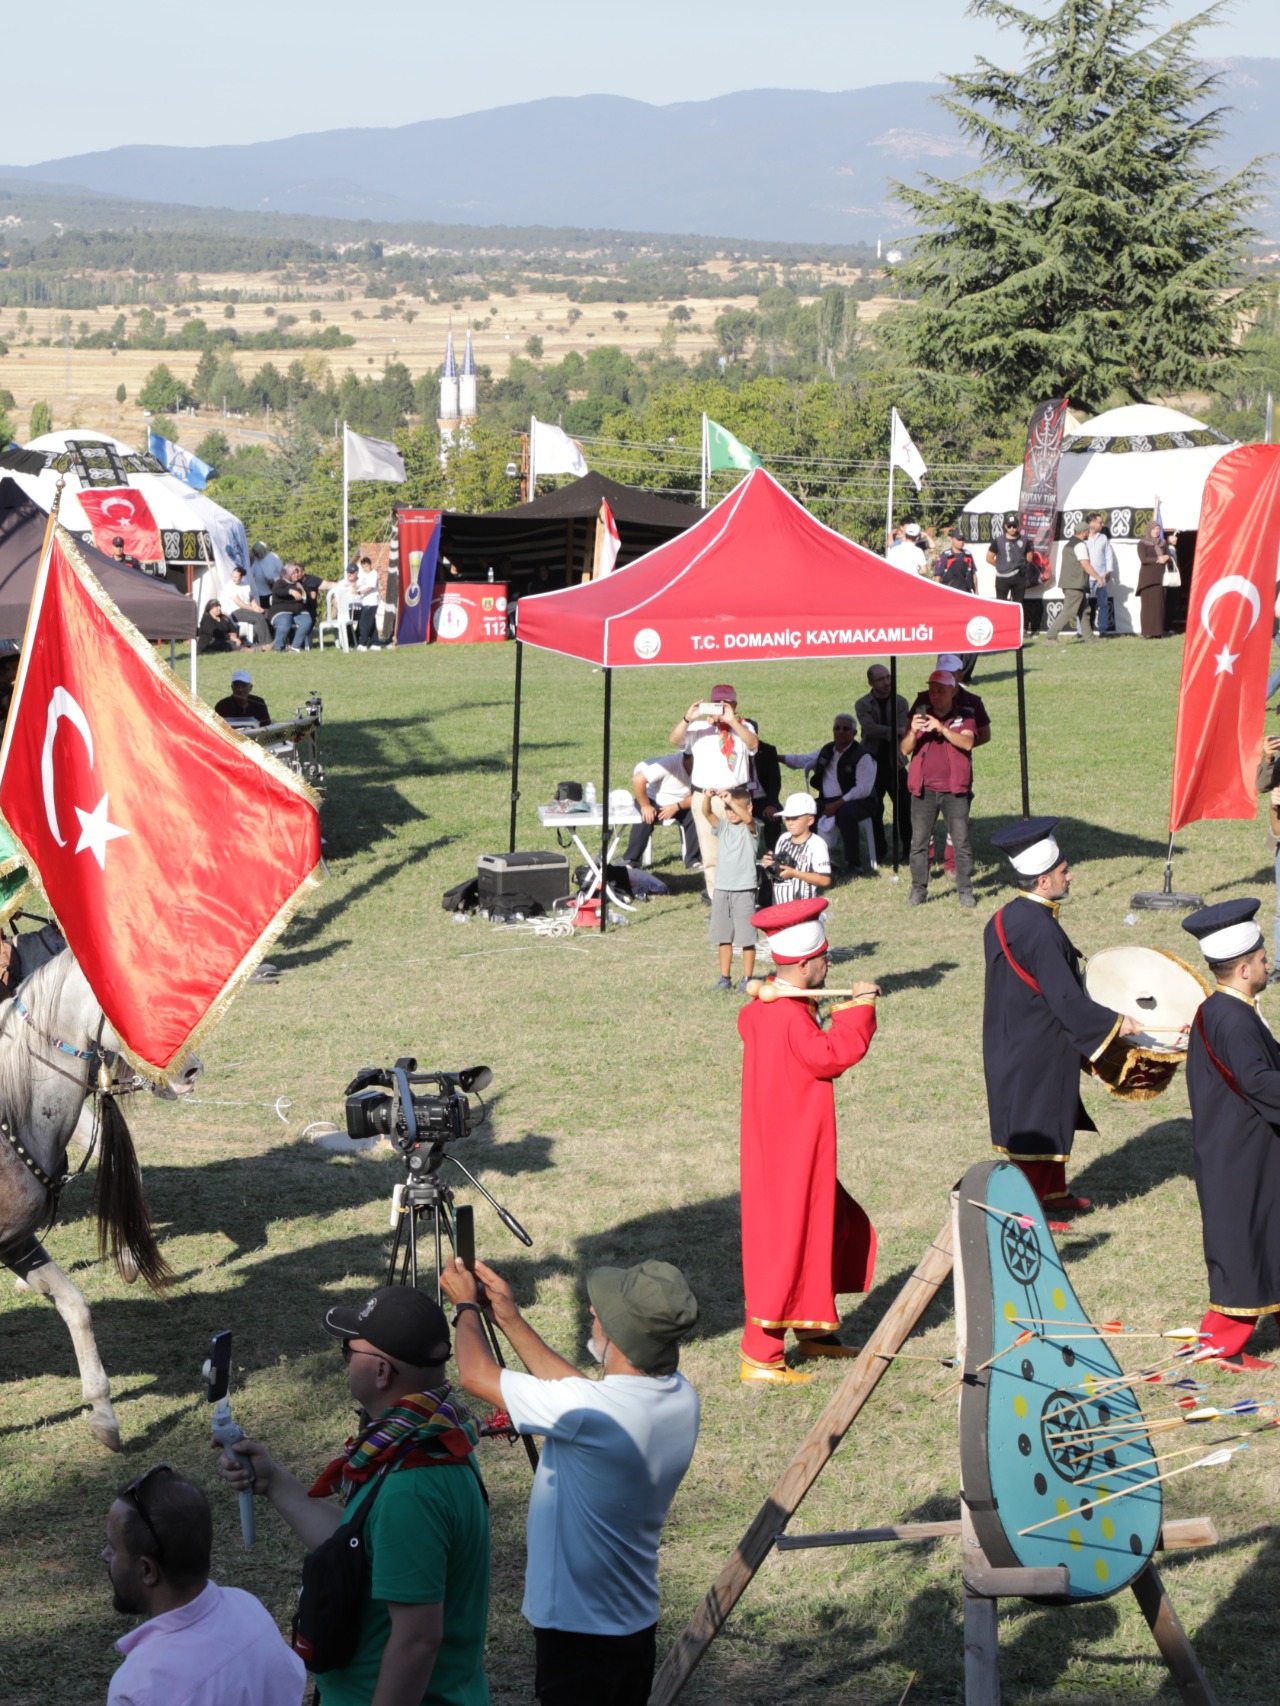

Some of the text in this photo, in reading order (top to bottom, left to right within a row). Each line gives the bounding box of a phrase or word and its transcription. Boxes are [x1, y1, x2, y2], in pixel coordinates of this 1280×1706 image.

[483, 621, 507, 636] 112
[690, 623, 934, 650] T.C. DOMANİÇ KAYMAKAMLIĞI
